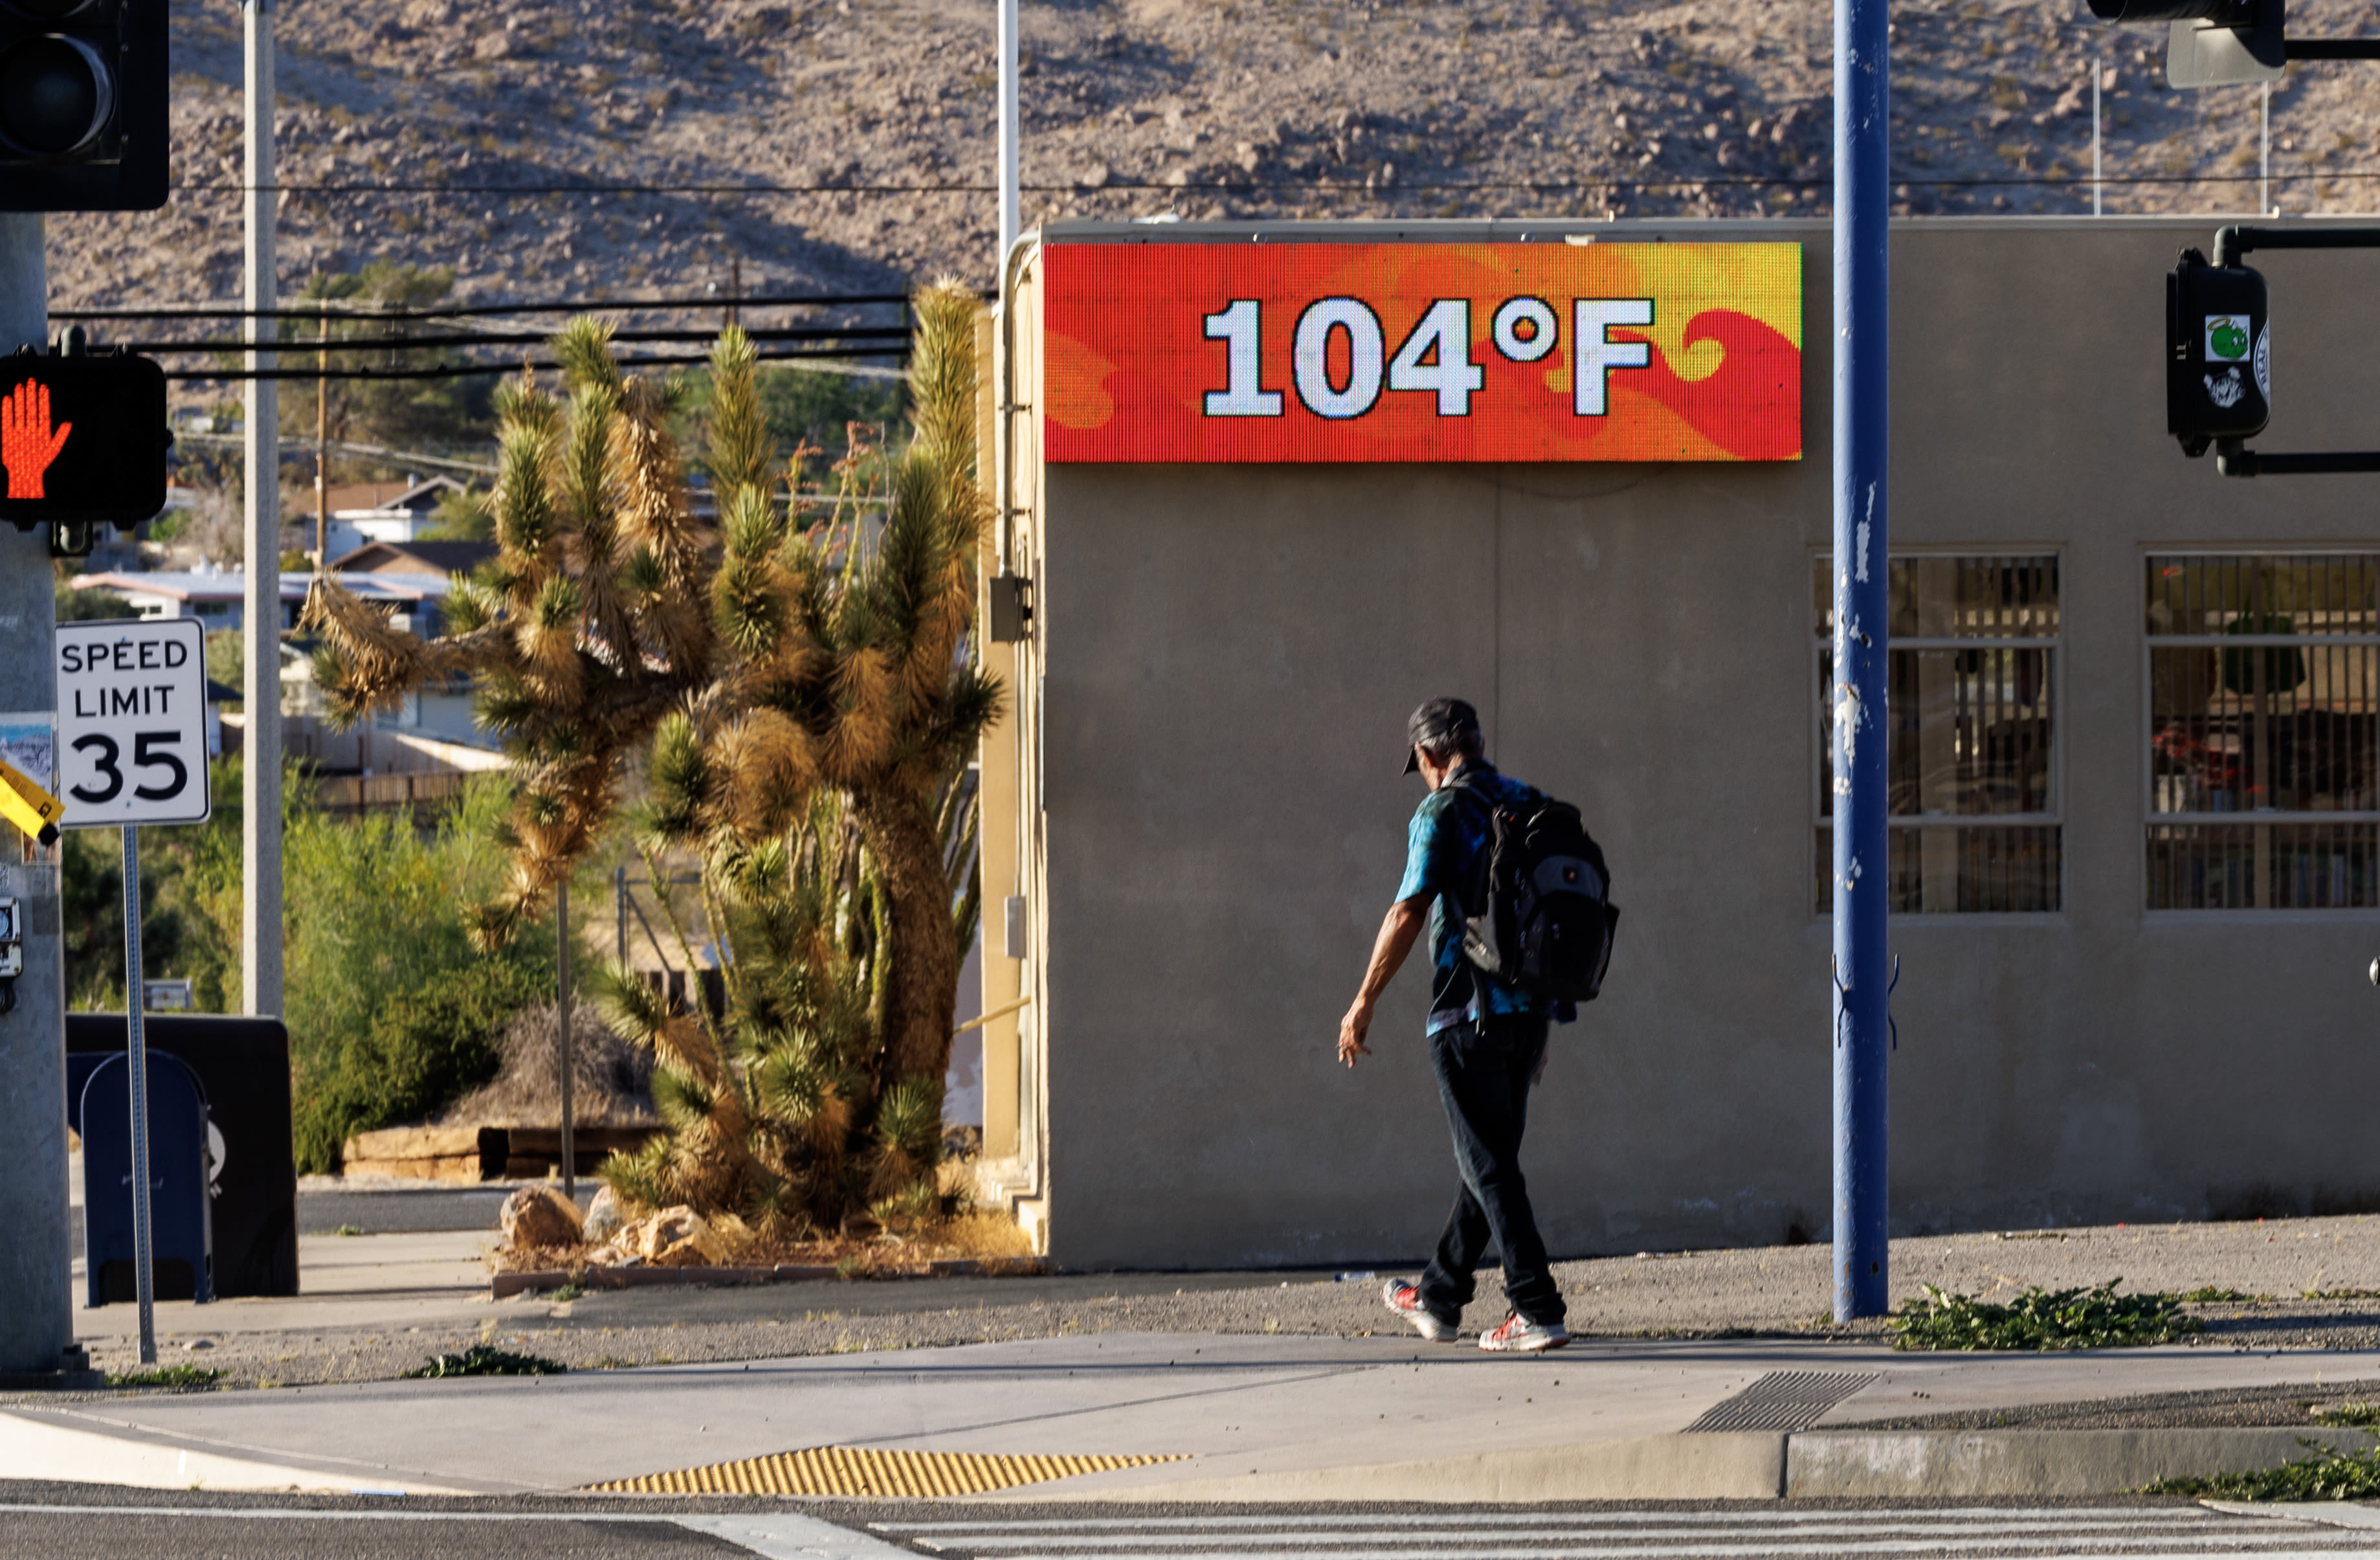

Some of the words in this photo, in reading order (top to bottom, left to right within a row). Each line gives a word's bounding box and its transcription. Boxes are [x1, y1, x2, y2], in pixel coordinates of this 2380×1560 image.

[1203, 296, 1654, 419] 104°F
[61, 640, 188, 673] SPEED
[75, 685, 175, 717] LIMIT
[69, 730, 188, 804] 35
